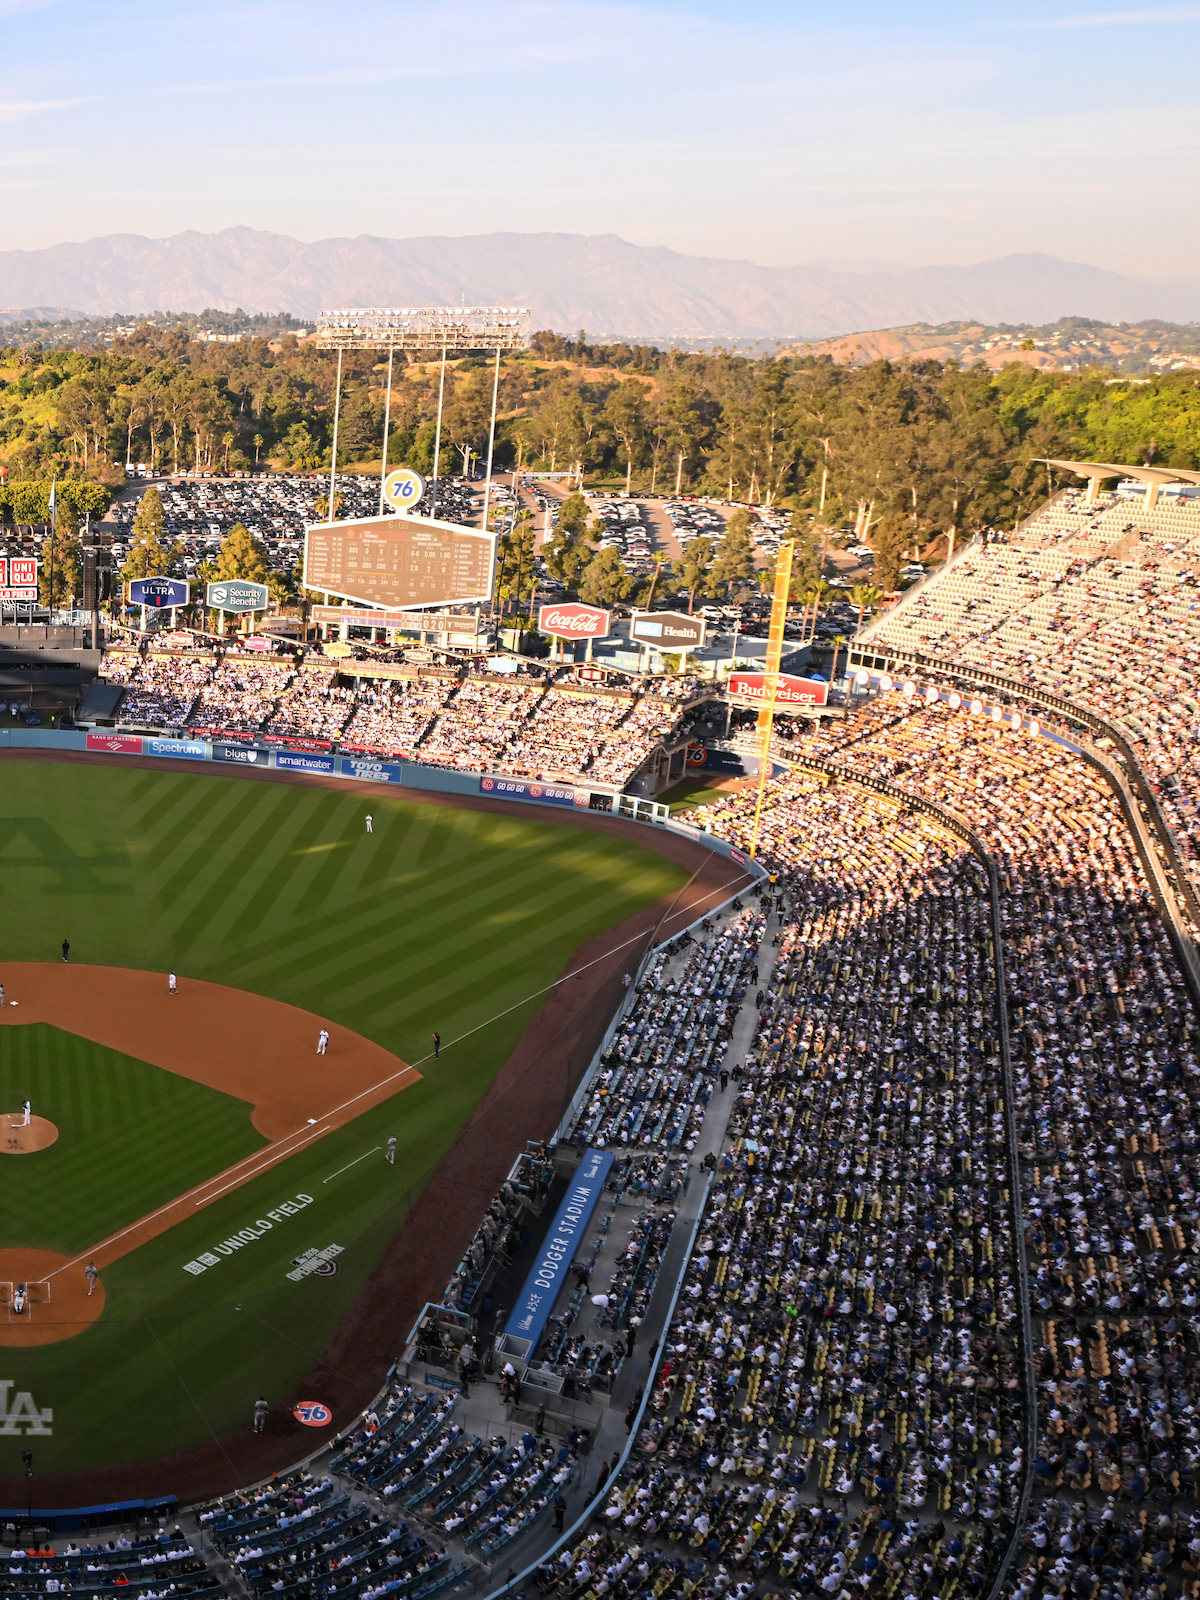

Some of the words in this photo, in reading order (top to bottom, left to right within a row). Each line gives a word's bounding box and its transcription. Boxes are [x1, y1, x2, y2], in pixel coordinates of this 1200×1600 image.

[392, 480, 416, 498] 76
[388, 521, 409, 530] 6:08
[14, 563, 32, 572] UNI
[14, 573, 34, 583] QLO
[142, 586, 175, 596] ULTRA
[230, 588, 262, 600] Security
[230, 598, 257, 606] Benefit
[424, 620, 428, 628] 0
[431, 620, 436, 630] 2
[438, 621, 444, 630] 0
[545, 611, 601, 632] Coca-Cola
[664, 626, 698, 638] Health
[168, 634, 192, 644] Churu
[737, 682, 816, 702] Budweiser
[152, 741, 199, 754] Spectrum
[225, 748, 246, 758] blue
[686, 748, 704, 762] 76
[278, 756, 332, 770] smartwater
[350, 760, 382, 771] TOYO
[354, 769, 388, 780] TIRES
[497, 782, 506, 790] GO
[506, 784, 514, 792] GO
[516, 785, 524, 793] GO
[546, 788, 554, 797] GO
[555, 790, 564, 798] GO
[564, 792, 573, 800] GO
[576, 796, 588, 804] 76
[214, 1219, 274, 1256] UNIQLO
[266, 1194, 314, 1222] FIELD
[534, 1238, 569, 1288] DODGER
[558, 1186, 592, 1234] STADIUM
[302, 1248, 320, 1260] 2026
[285, 1256, 325, 1282] OPENING
[315, 1243, 346, 1265] WEEK
[526, 1293, 542, 1312] ようこそ
[298, 1405, 328, 1422] 76
